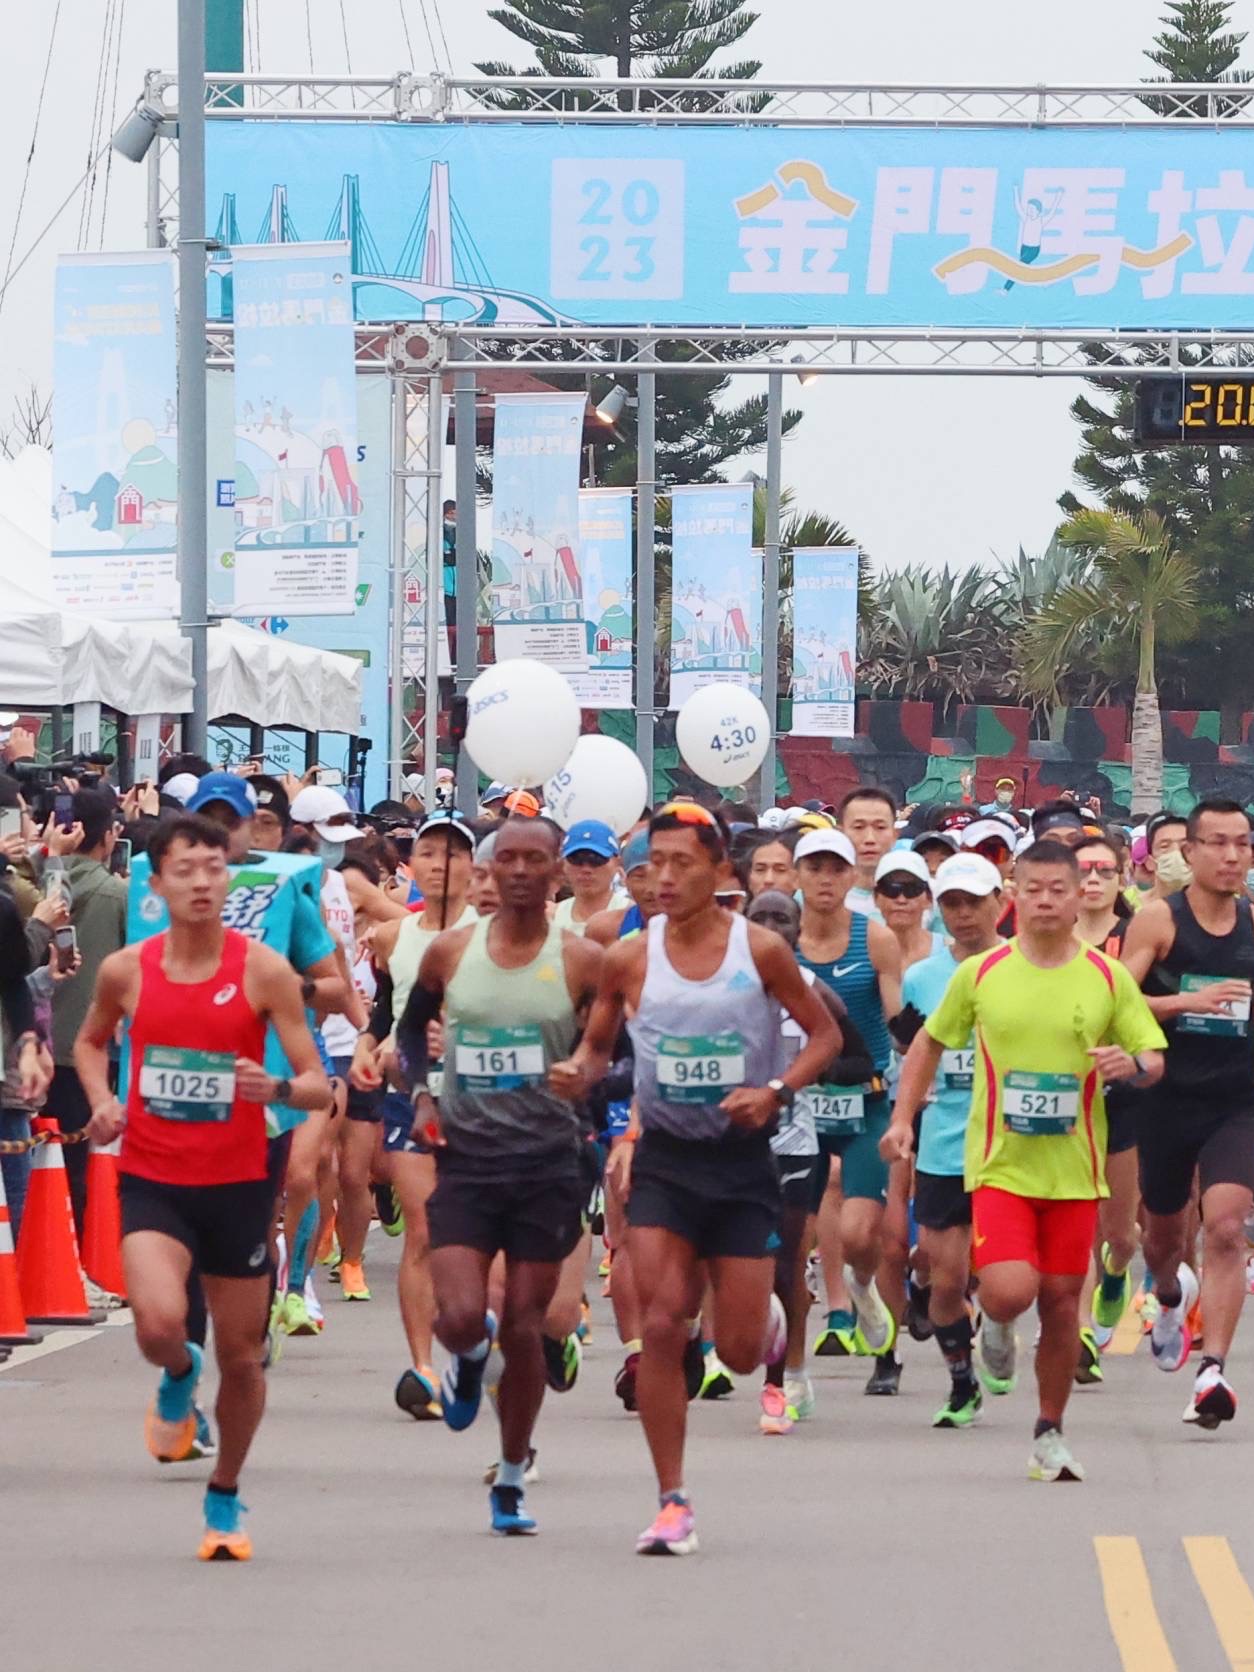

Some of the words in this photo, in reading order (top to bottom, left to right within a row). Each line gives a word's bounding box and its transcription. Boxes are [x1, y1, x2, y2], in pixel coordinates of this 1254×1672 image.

[578, 178, 660, 225] 20
[578, 235, 656, 282] 23
[710, 726, 756, 752] 4:30
[475, 1050, 517, 1072] 161
[674, 1060, 722, 1083] 948
[155, 1072, 219, 1099] 1025
[812, 1096, 853, 1117] 1247
[1020, 1094, 1060, 1114] 521
